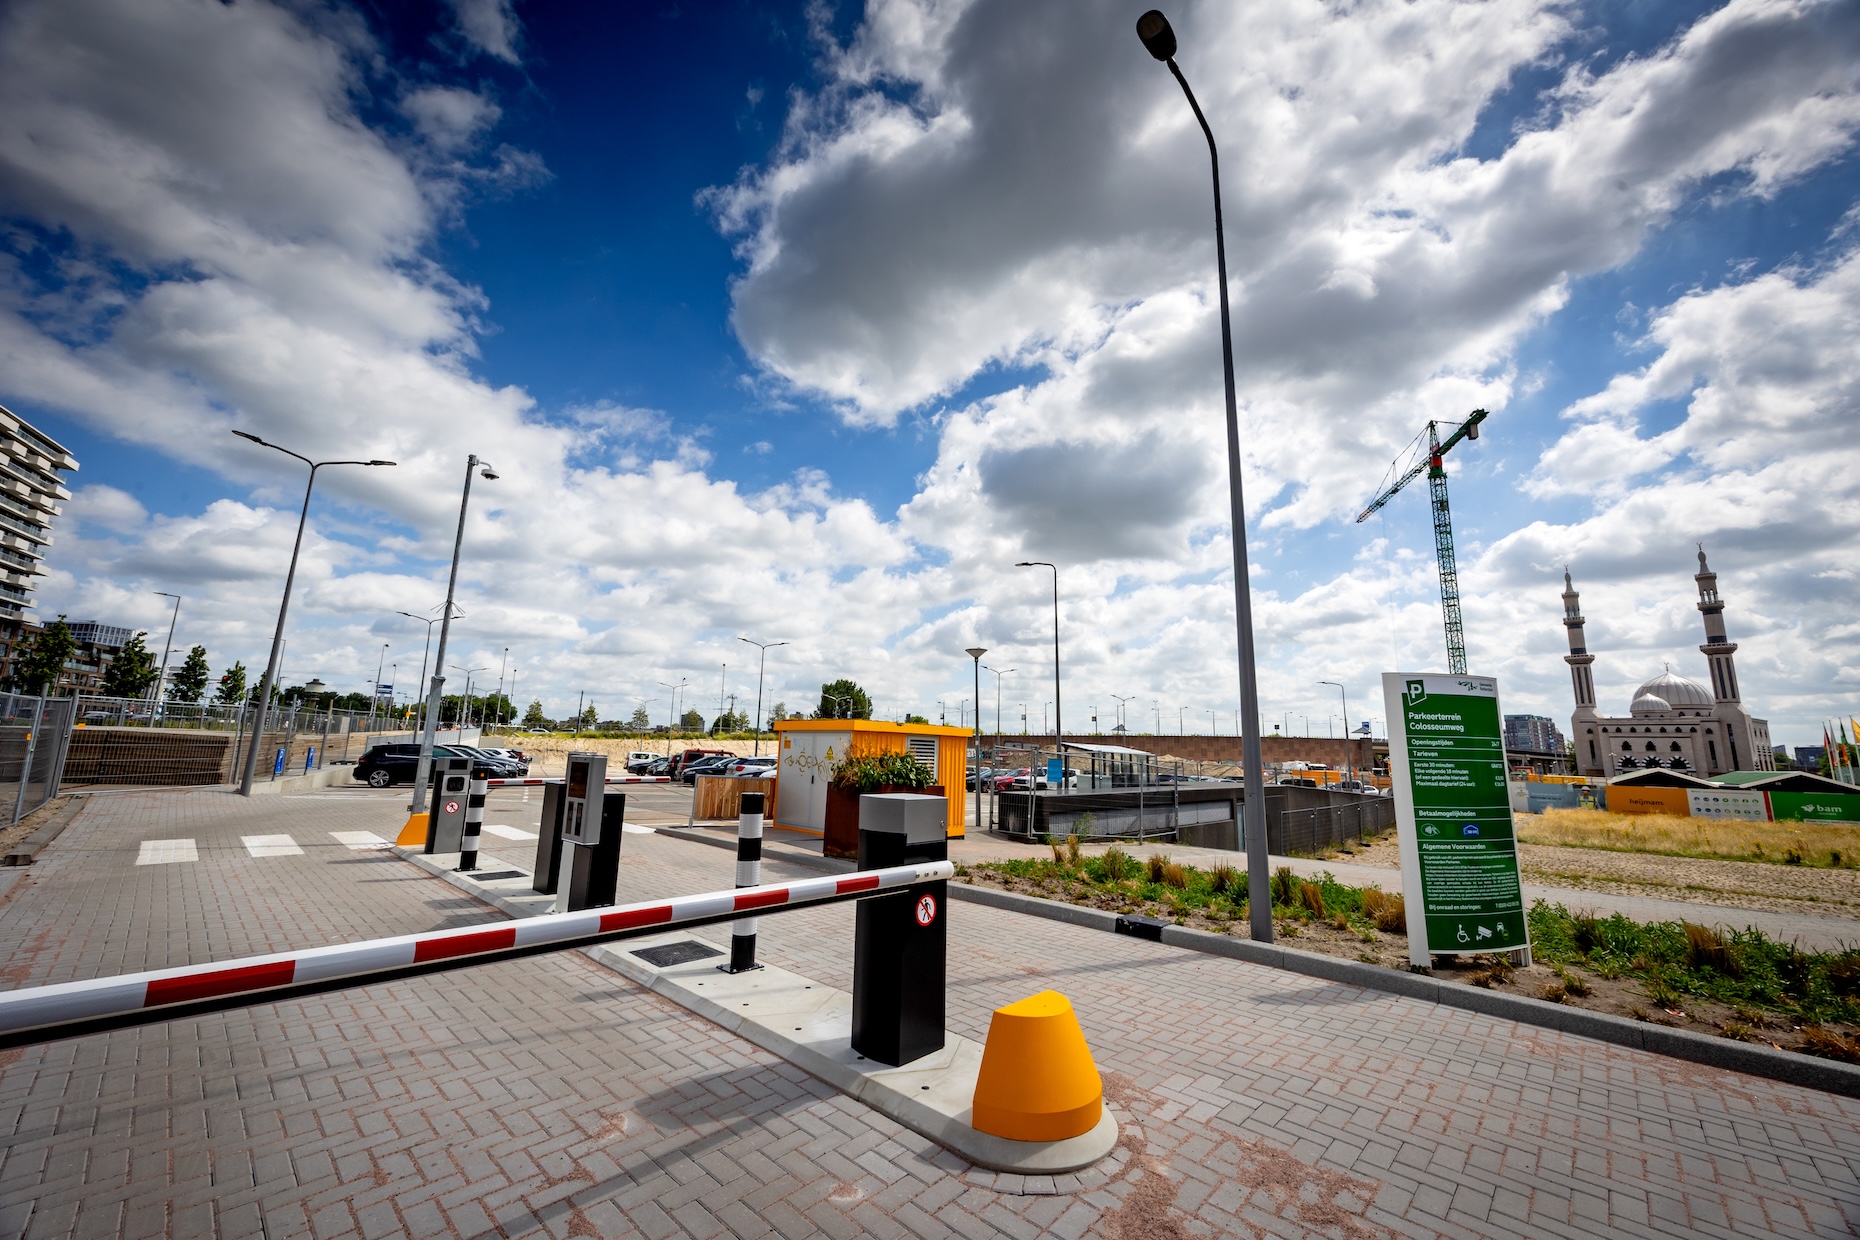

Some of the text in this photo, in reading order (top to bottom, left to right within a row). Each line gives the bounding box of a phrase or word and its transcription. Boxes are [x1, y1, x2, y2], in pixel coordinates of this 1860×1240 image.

[1410, 684, 1422, 698] P
[1408, 712, 1462, 721] Parkeerterrein
[1410, 722, 1464, 732] Colosseumweg
[1411, 738, 1454, 746] Openingstijden
[1816, 804, 1842, 812] bam
